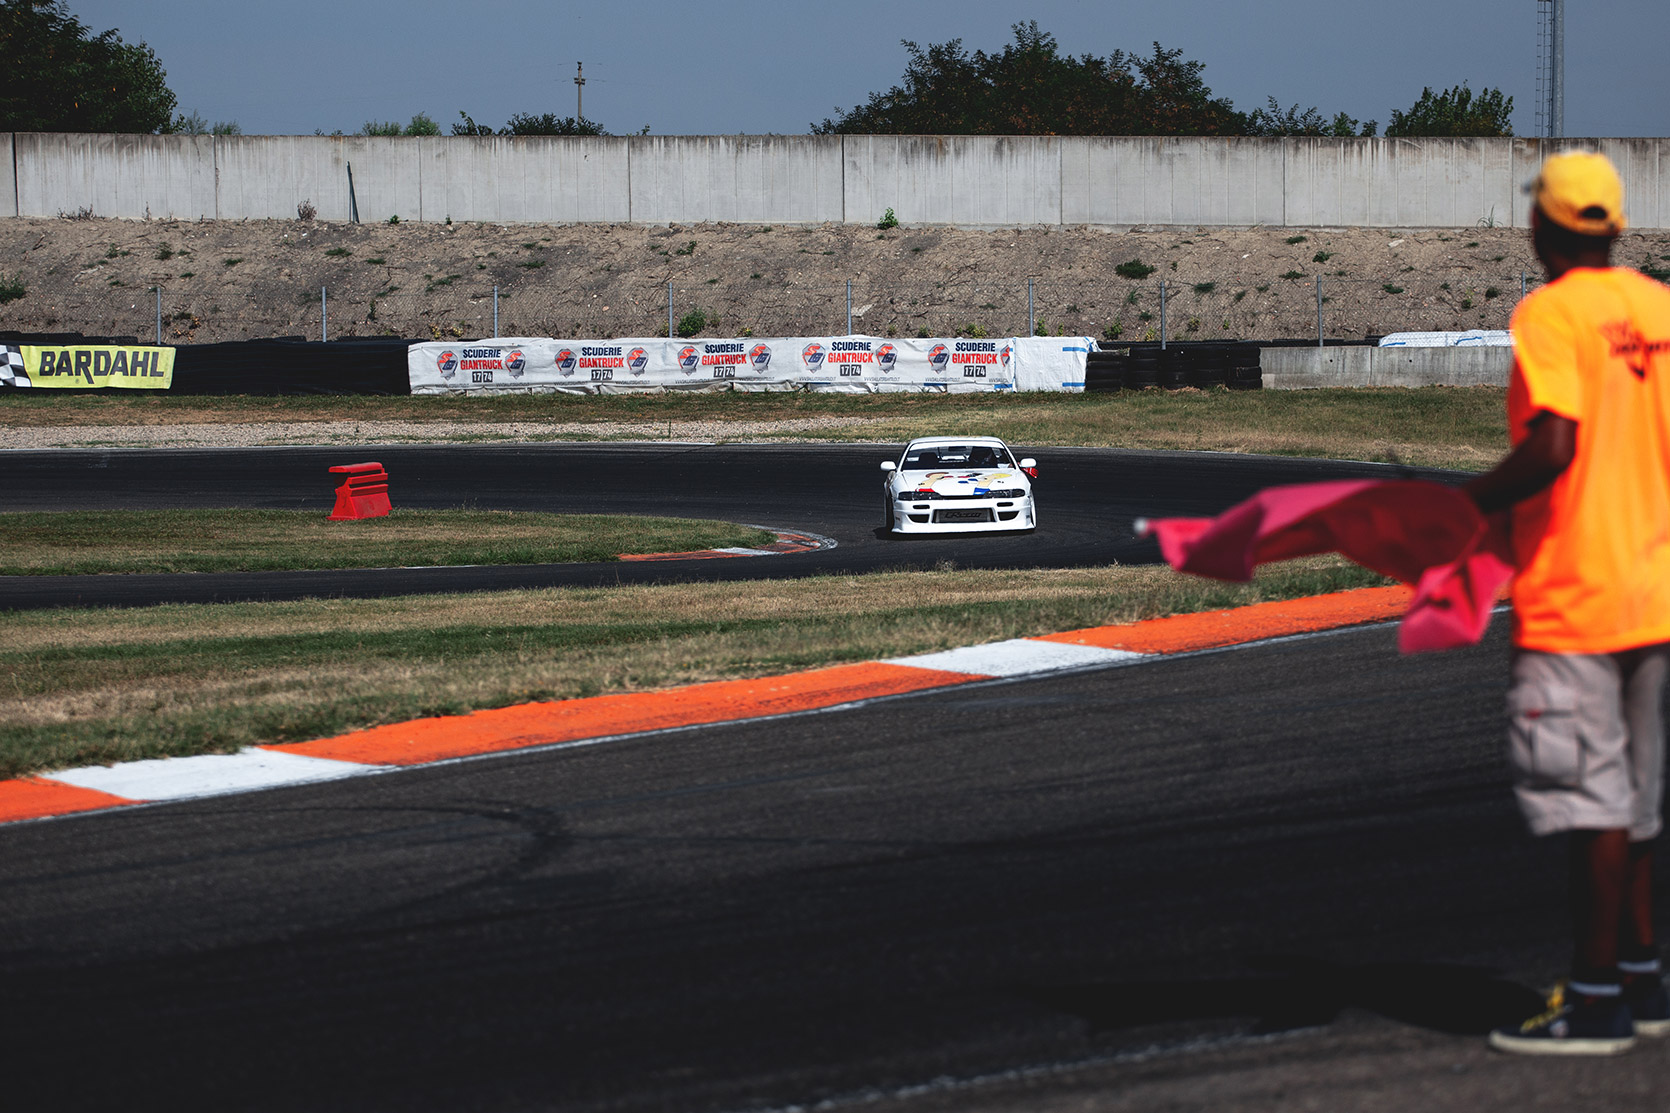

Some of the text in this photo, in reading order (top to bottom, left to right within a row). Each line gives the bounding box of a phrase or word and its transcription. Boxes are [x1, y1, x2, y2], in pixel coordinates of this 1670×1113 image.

[582, 347, 622, 356] SCUDERIE
[705, 343, 744, 353] SCUDERIE
[832, 342, 871, 351] SCUDERIE
[955, 342, 995, 352] SCUDERIE
[463, 349, 501, 358] SCUDERIE
[828, 353, 874, 363] GIANTRUCK
[952, 353, 998, 364] GIANTRUCK
[579, 357, 624, 368] GIANTRUCK
[702, 354, 747, 365] GIANTRUCK
[39, 350, 164, 384] BARDAHL
[460, 360, 503, 370] GIANTRUCK
